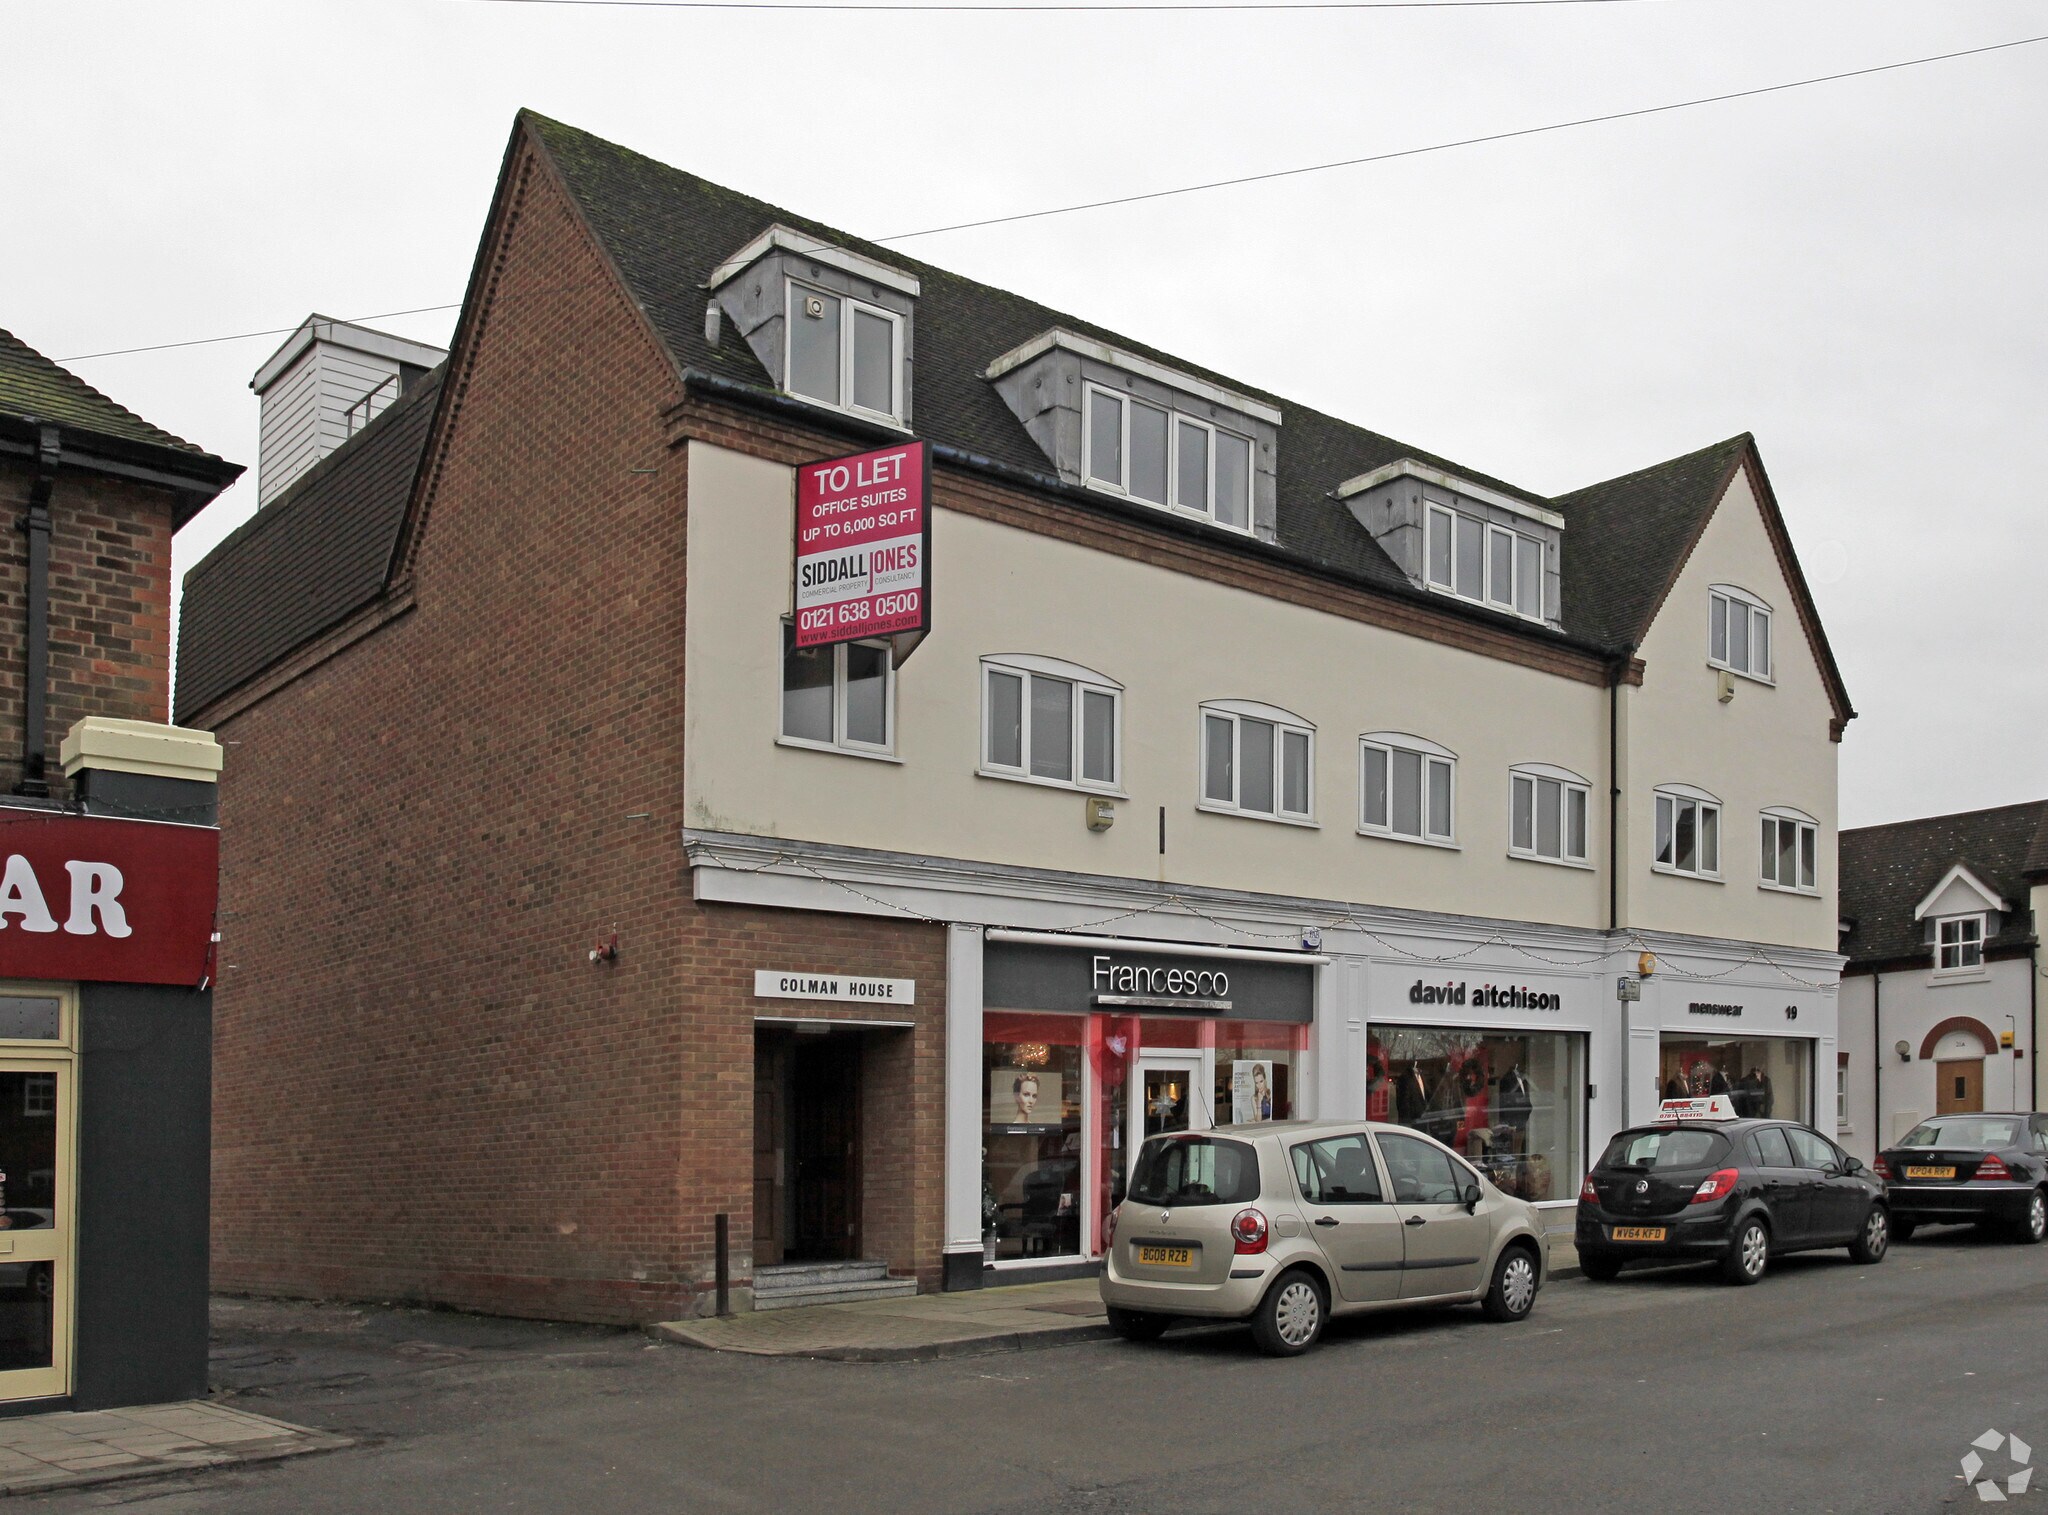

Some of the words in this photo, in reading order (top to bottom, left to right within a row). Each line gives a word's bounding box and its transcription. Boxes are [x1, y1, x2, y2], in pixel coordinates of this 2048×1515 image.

[814, 465, 850, 495] TO
[857, 452, 907, 487] LET
[812, 497, 858, 518] OFFICE
[861, 487, 907, 508] SUITES
[803, 527, 821, 542] UP
[824, 523, 841, 538] TO
[843, 516, 875, 535] 6,000
[878, 512, 897, 527] SQ
[900, 508, 917, 523] FT
[802, 553, 868, 588] SIDDALL
[867, 543, 917, 594] JONES
[801, 587, 838, 599] COMMERCIAL
[838, 580, 868, 592] PROPERTY
[874, 571, 916, 585] CONSULTANCY
[800, 606, 834, 630] 0121
[838, 600, 871, 624] 638
[875, 591, 919, 617] 0500
[800, 614, 918, 643] www.siddalljones.com
[780, 977, 838, 995] COLMAN
[849, 981, 893, 998] HOUSE
[1093, 955, 1229, 997] Francesco
[1409, 979, 1466, 1005] david
[1472, 983, 1561, 1011] aitchison
[1689, 1002, 1743, 1016] menswear
[1785, 1005, 1798, 1020] 19
[1642, 1229, 1661, 1239] KFD
[1168, 1249, 1188, 1263] RZB
